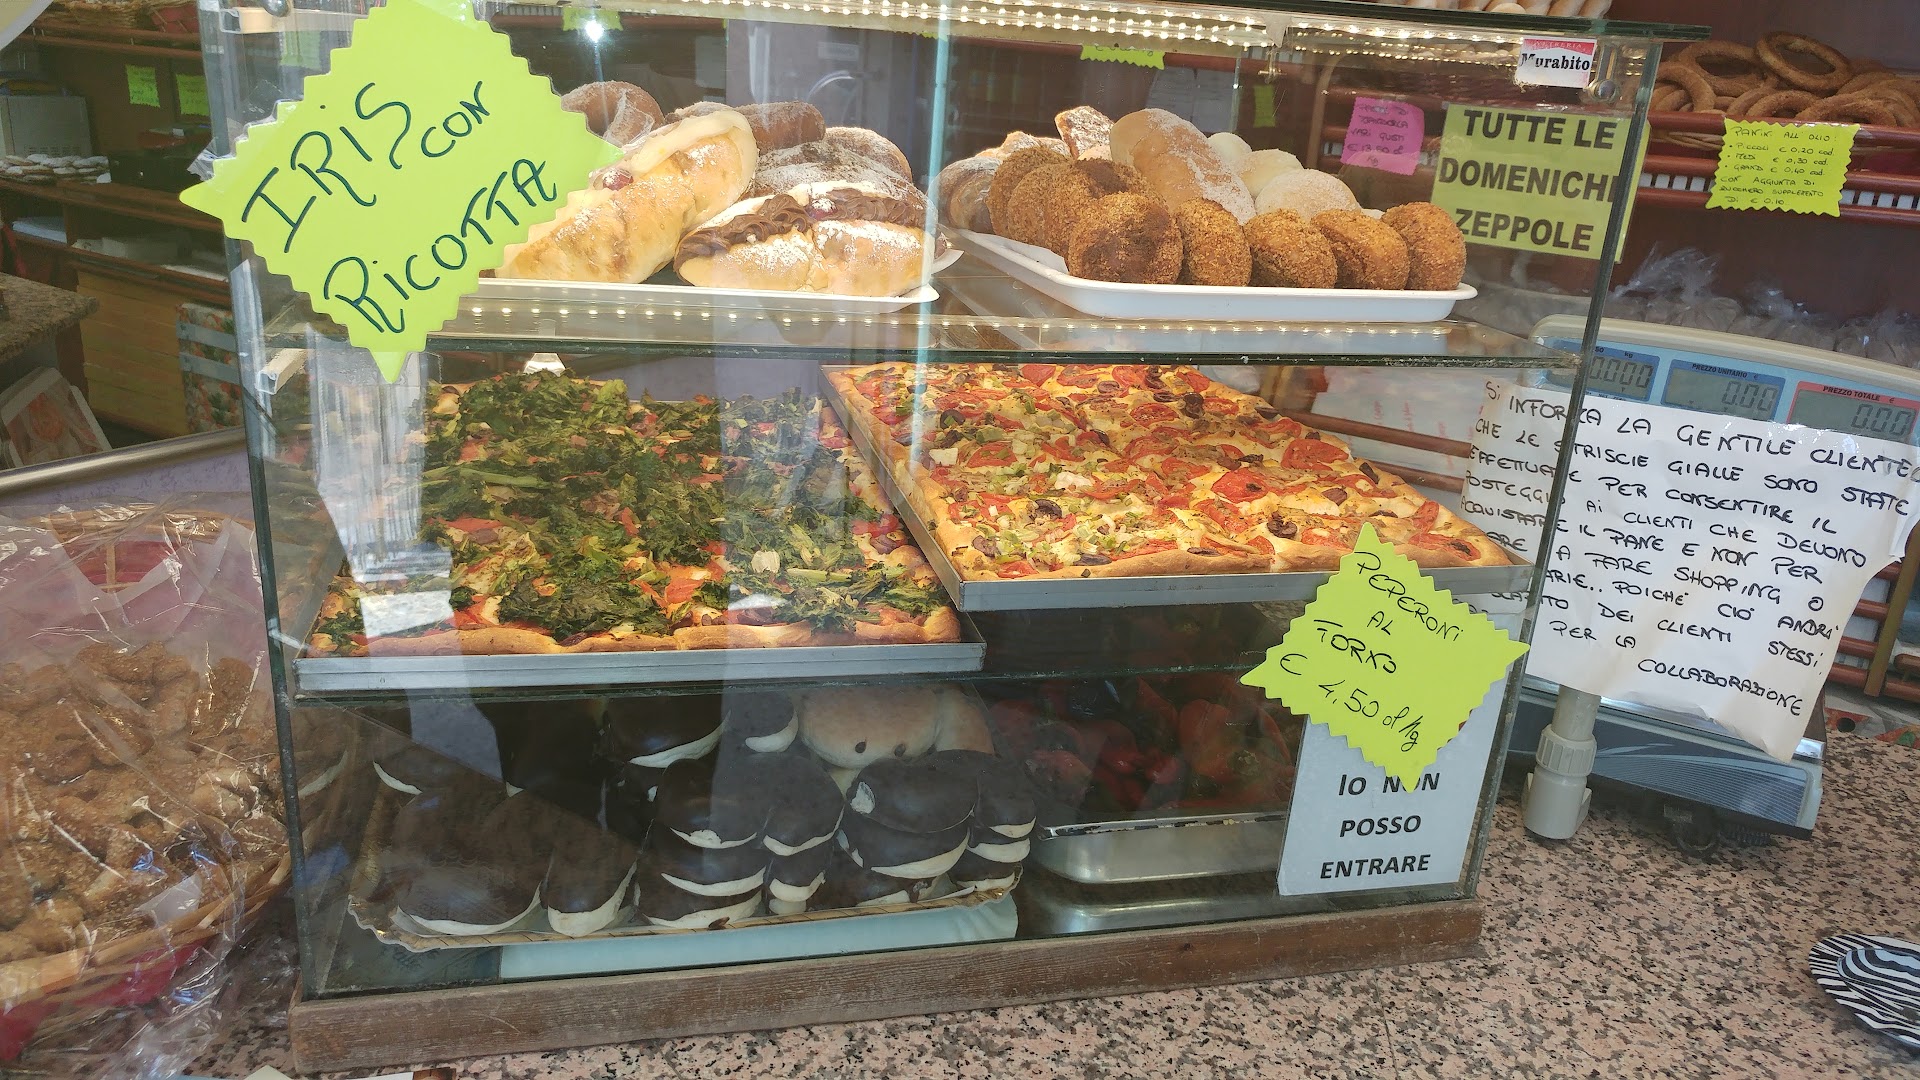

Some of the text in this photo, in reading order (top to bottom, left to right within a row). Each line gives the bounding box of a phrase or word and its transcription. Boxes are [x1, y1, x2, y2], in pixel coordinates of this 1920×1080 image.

[1520, 53, 1590, 71] Murabito
[1463, 109, 1618, 150] TUTTE LE
[242, 80, 490, 254] IRIS CON
[1752, 176, 1796, 186] AGGIUNTA
[1455, 207, 1595, 252] ZEPPOLE
[1692, 363, 1717, 373] PREZZO
[1717, 367, 1748, 378] UNITARIO
[1721, 380, 1778, 412] 0.00
[1822, 386, 1852, 396] PREZZO
[1852, 391, 1880, 402] TOTALE
[1616, 417, 1651, 435] LA
[1676, 424, 1797, 456] GENTILE
[1850, 403, 1912, 437] 0.00
[1475, 418, 1502, 439] CHE
[1515, 430, 1540, 448] LE
[1667, 460, 1744, 482] GIALLE
[1763, 474, 1819, 494] SONO
[1840, 486, 1910, 517] STATE
[1469, 444, 1837, 534] EFFETTUAE PER CONSENTIRE IL
[1579, 524, 1596, 537] IL
[1602, 528, 1665, 552] PANE
[1681, 542, 1701, 556] E
[1710, 546, 1759, 567] NON
[1771, 556, 1823, 584] PER
[1623, 512, 1693, 530] CLIENTI
[1709, 523, 1758, 543] CHE
[1776, 532, 1867, 568] DEVONO
[1555, 545, 1571, 561] A
[1584, 552, 1653, 575] FARE
[1673, 566, 1781, 604] SHOPPING
[1807, 596, 1824, 612] O
[1366, 610, 1391, 635] AL
[1549, 620, 1637, 649] PER LA
[1597, 602, 1634, 623] DEI
[1657, 619, 1732, 643] CLIENTI
[1279, 653, 1308, 675] €
[1318, 679, 1380, 718] 4,50
[1637, 658, 1803, 716] COLLABORAZIONE
[1338, 774, 1367, 796] IO
[1339, 815, 1422, 838] POSSO
[1320, 854, 1431, 879] ENTRARE
